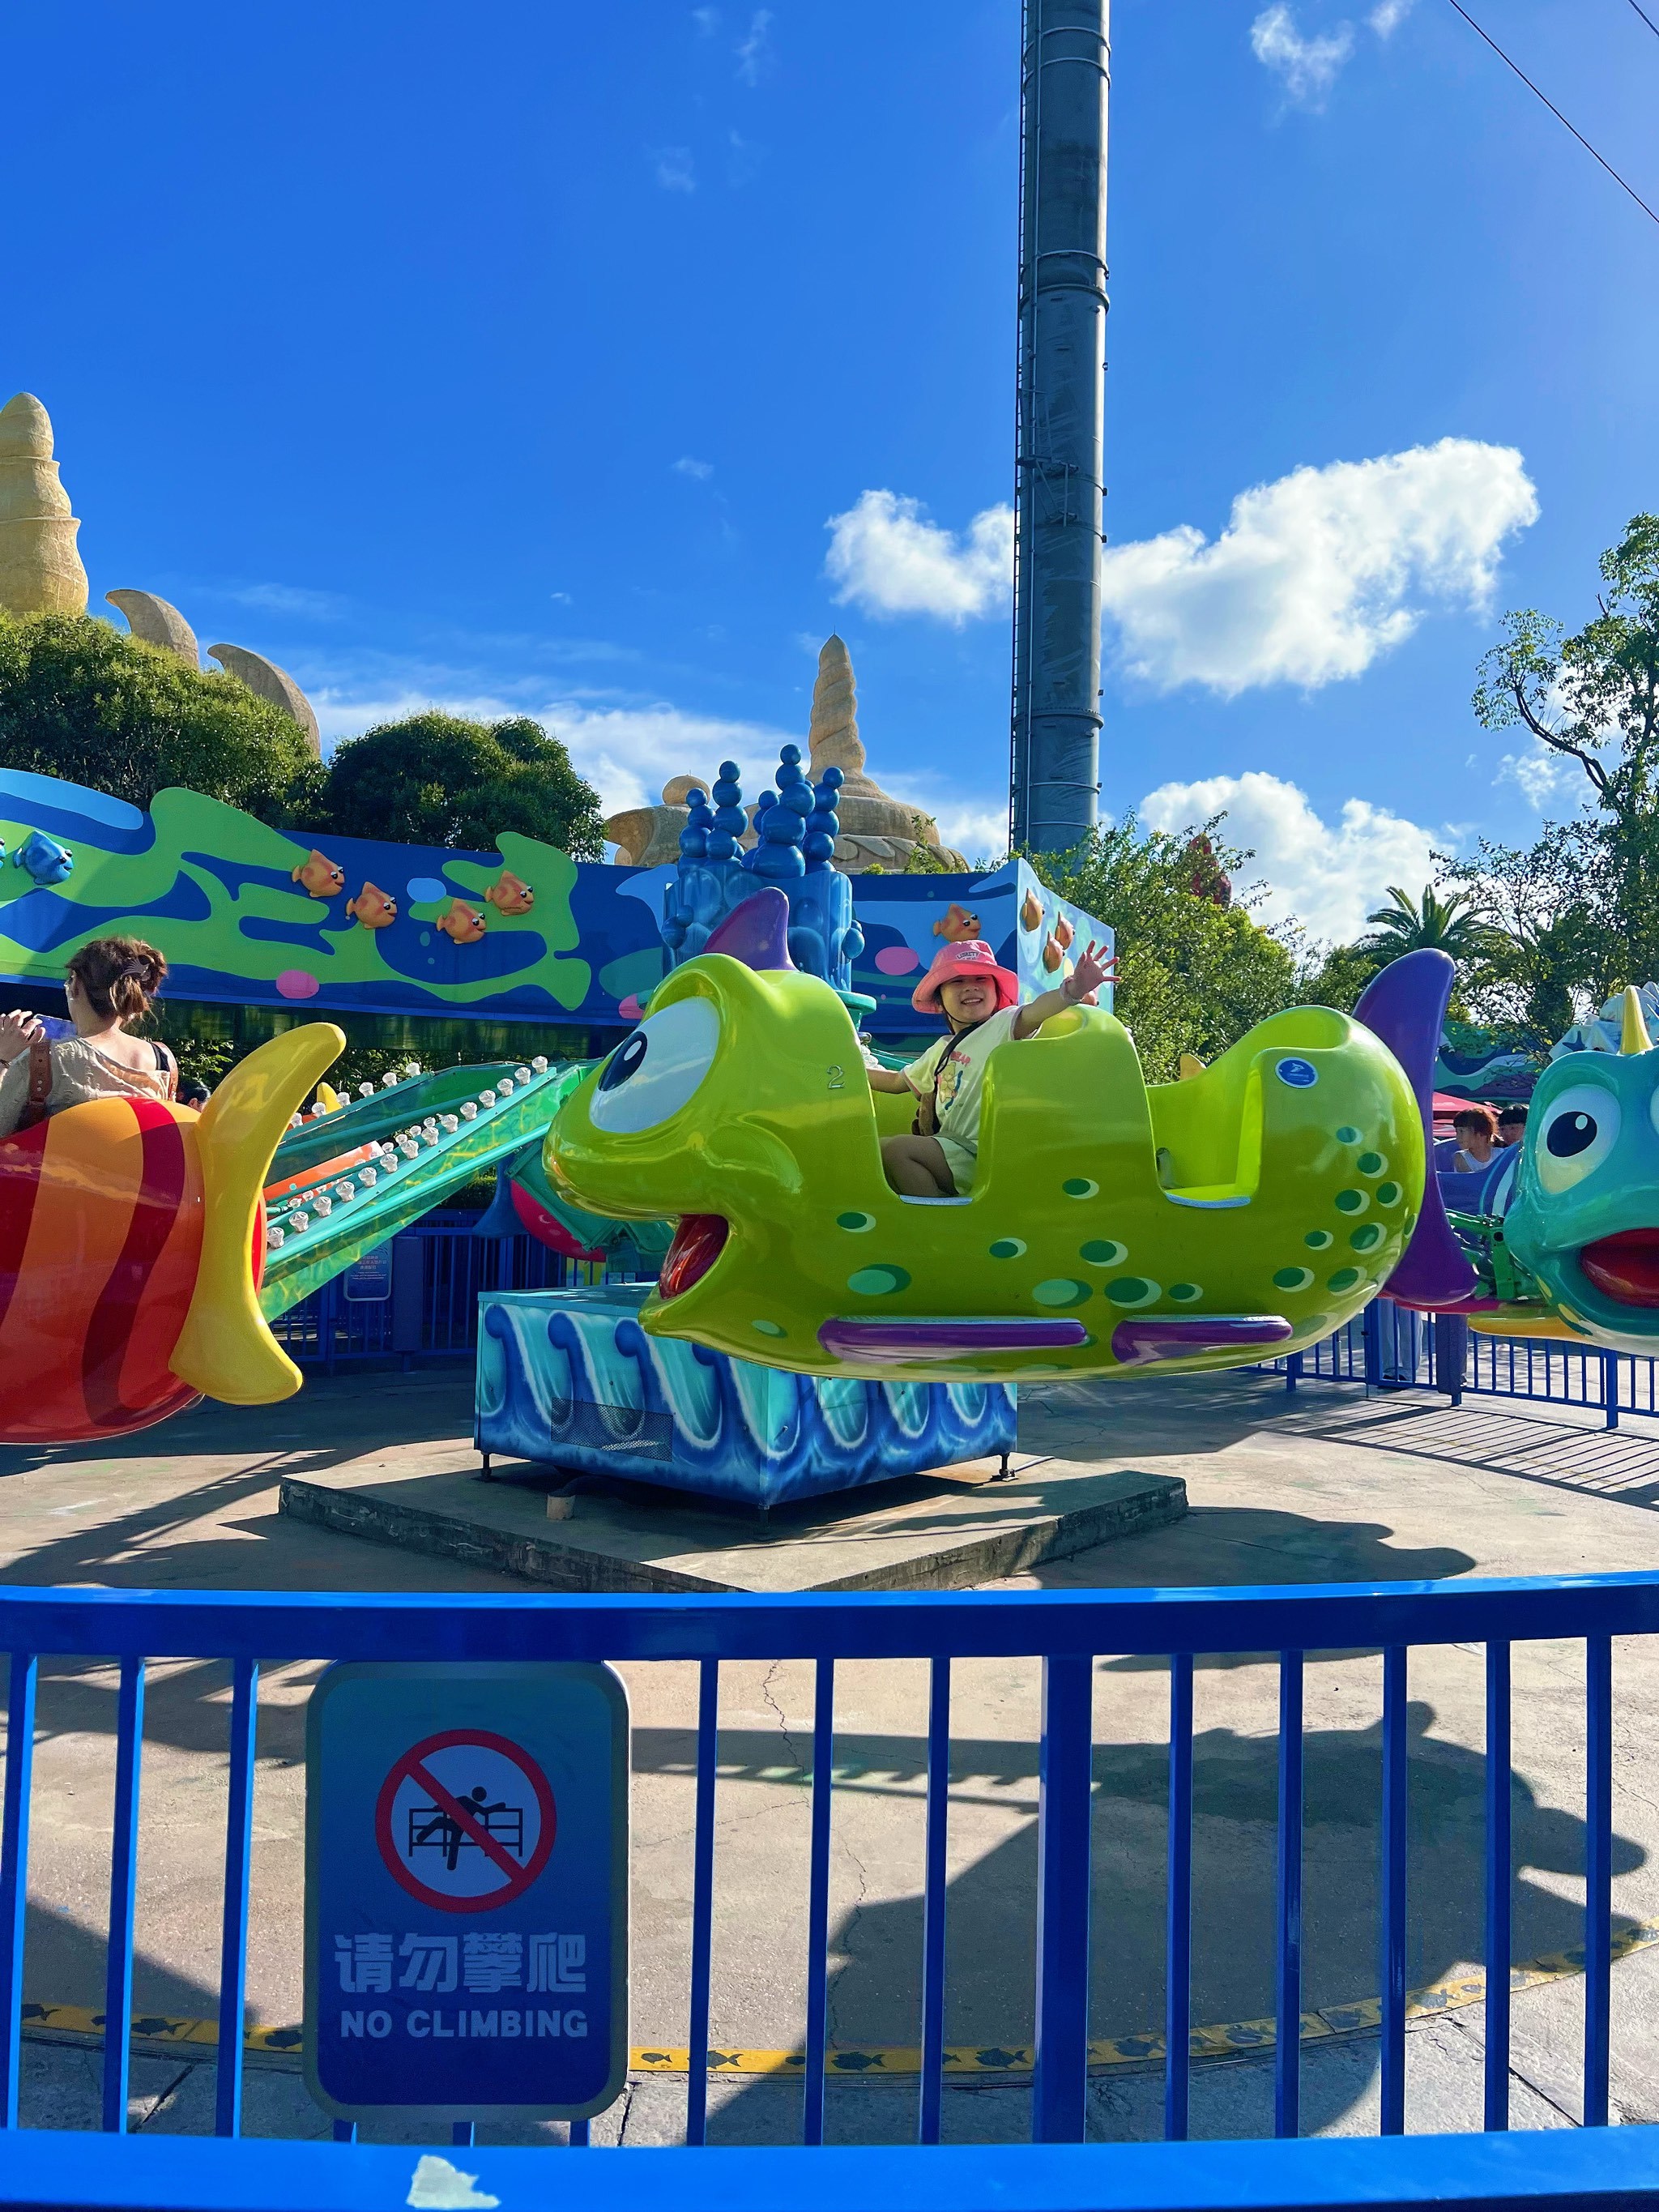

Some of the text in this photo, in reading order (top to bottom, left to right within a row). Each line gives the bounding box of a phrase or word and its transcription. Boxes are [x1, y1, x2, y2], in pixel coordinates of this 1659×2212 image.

[826, 1064, 846, 1090] 2
[334, 1932, 586, 1993] 请勿攀爬
[340, 2009, 588, 2038] NO CLIMBING
